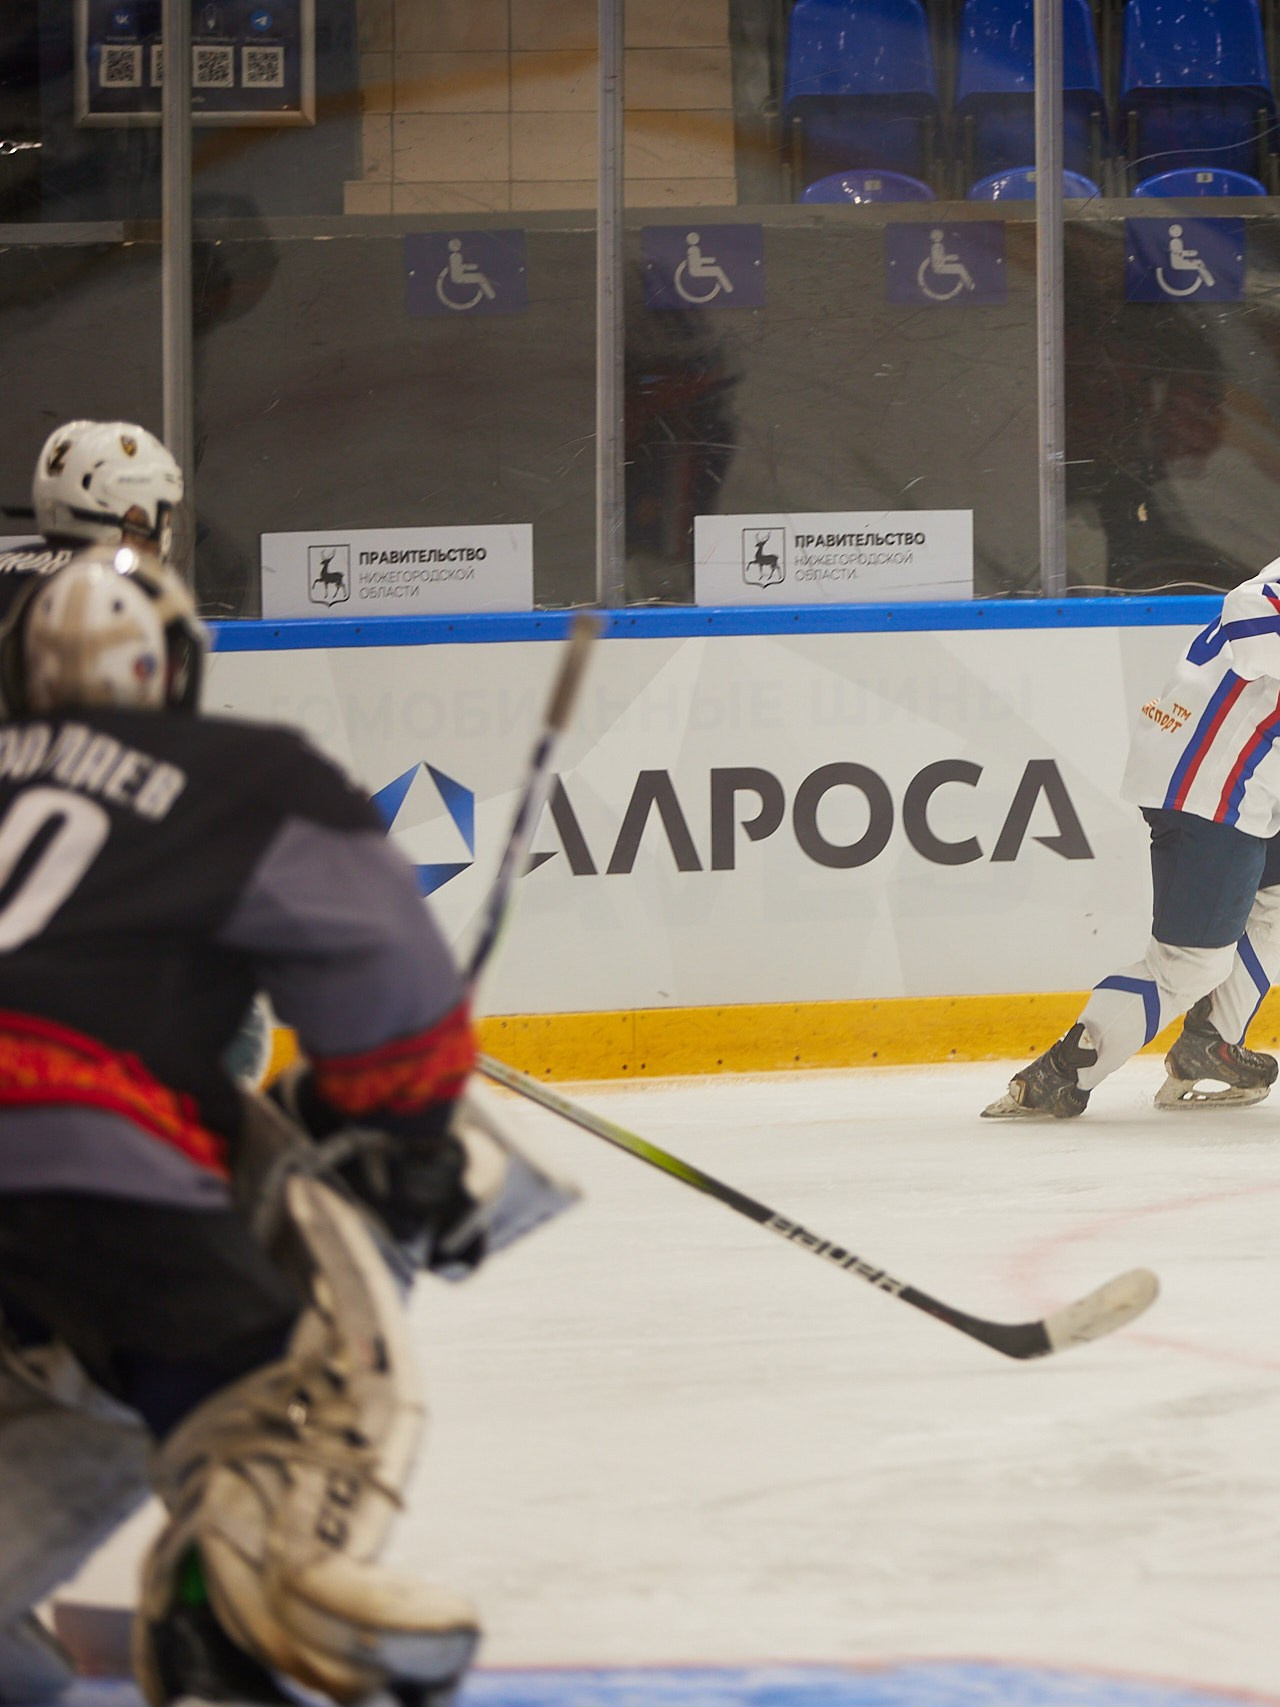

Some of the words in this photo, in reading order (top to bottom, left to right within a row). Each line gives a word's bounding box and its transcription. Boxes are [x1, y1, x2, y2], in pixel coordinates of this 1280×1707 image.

[795, 532, 926, 548] ПРАВИТЕЛЬСТВО
[359, 548, 487, 566] ПРАВИТЕЛЬСТВО
[794, 550, 914, 566] НИЖЕГОРОДСКОЙ
[359, 566, 475, 583] НИЖЕГОРОДСКОЙ
[794, 568, 858, 582] ОБЛАСТИ
[359, 584, 420, 600] ОБЛАСТИ
[270, 680, 787, 743] ОМОБИЬНЫЕ
[498, 757, 1095, 879] АЛРОСА
